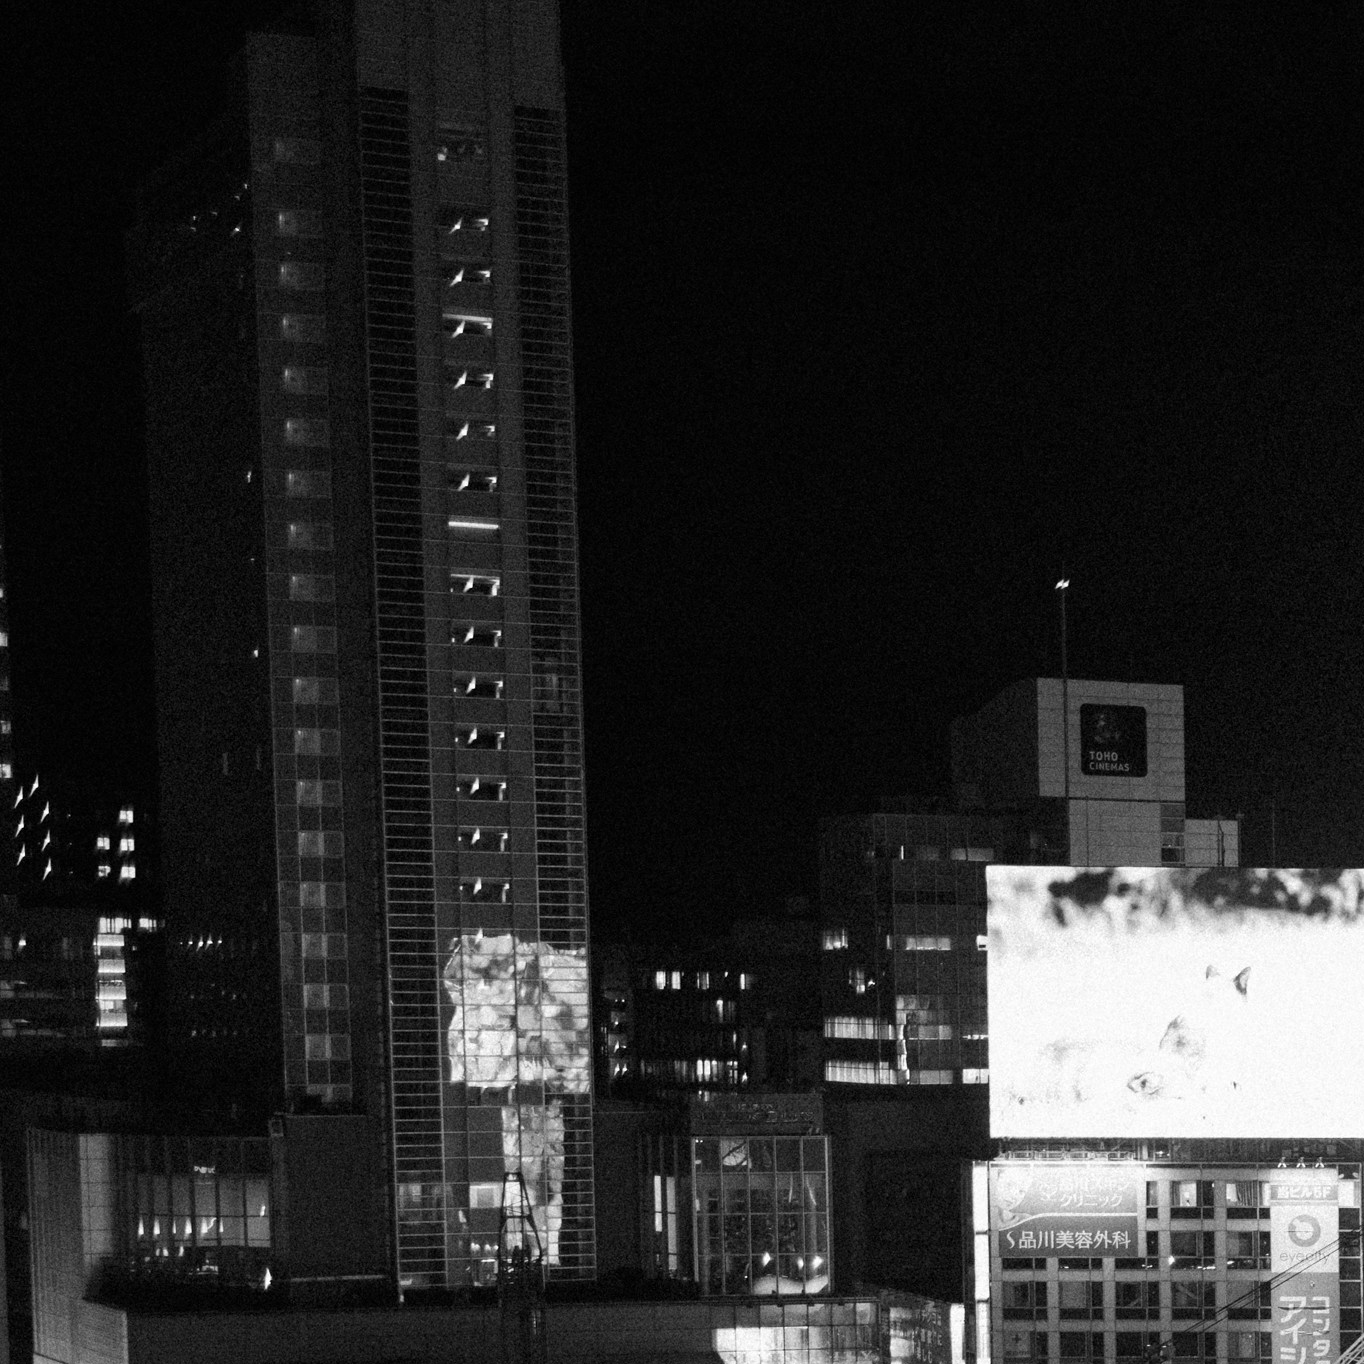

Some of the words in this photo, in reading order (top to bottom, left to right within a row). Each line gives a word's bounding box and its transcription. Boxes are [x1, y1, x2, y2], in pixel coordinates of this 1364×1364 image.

[1090, 751, 1118, 762] TOHO
[1089, 762, 1131, 773] CINEMAS
[1019, 1230, 1130, 1249] 品川美容外科
